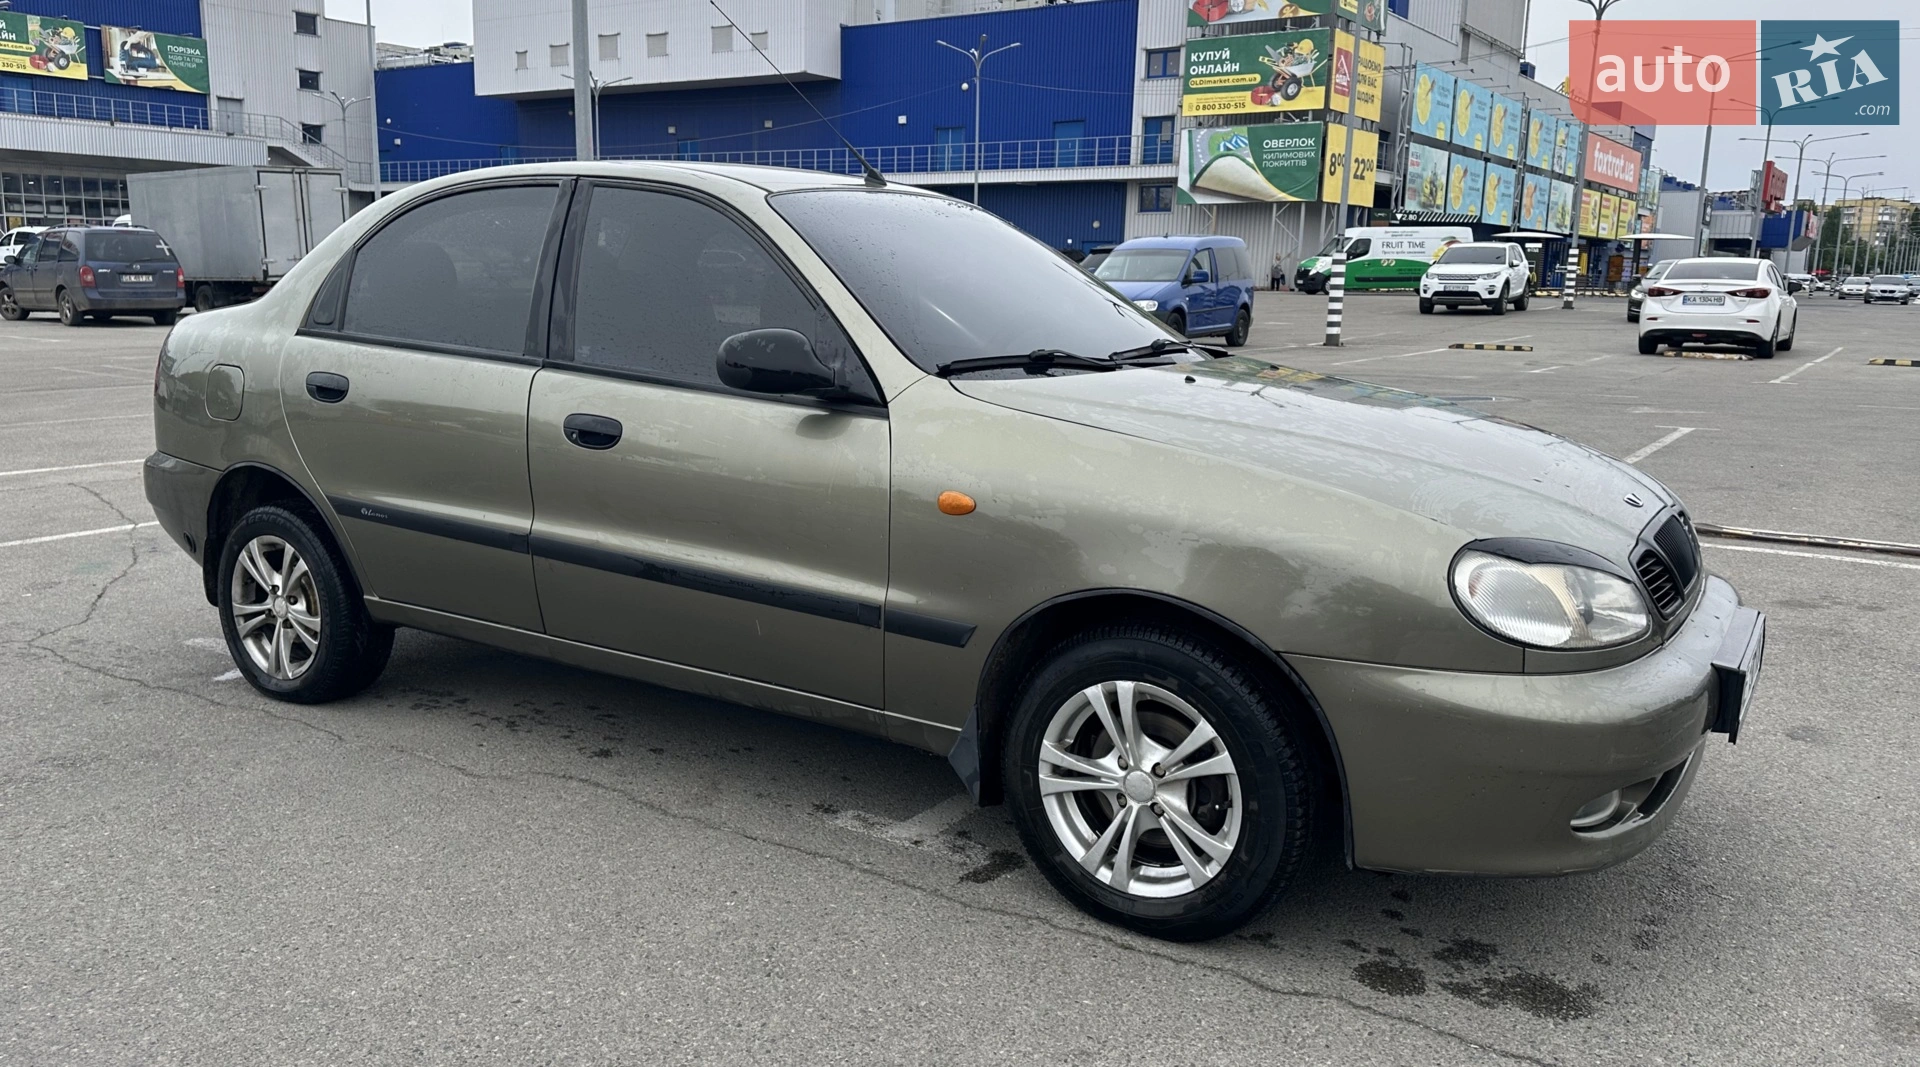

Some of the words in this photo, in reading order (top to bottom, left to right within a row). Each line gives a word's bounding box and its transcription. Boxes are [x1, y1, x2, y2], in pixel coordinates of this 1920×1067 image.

[0, 31, 16, 40] ЙН
[167, 45, 201, 55] ПОРІЗКА
[1191, 48, 1230, 62] КУПУЙ
[1189, 61, 1240, 75] ОНЛАЙН
[1202, 103, 1216, 111] 800
[1217, 102, 1246, 110] 330-515
[1262, 137, 1316, 148] ОВЕРЛОК
[1263, 151, 1316, 160] КИЛИМОВИХ
[1262, 159, 1307, 168] ПОКРИТТІВ
[1593, 141, 1635, 183] foxtrot.ua
[1402, 213, 1417, 221] 2.80
[1381, 241, 1404, 249] FRUIT
[1407, 241, 1426, 249] TIME
